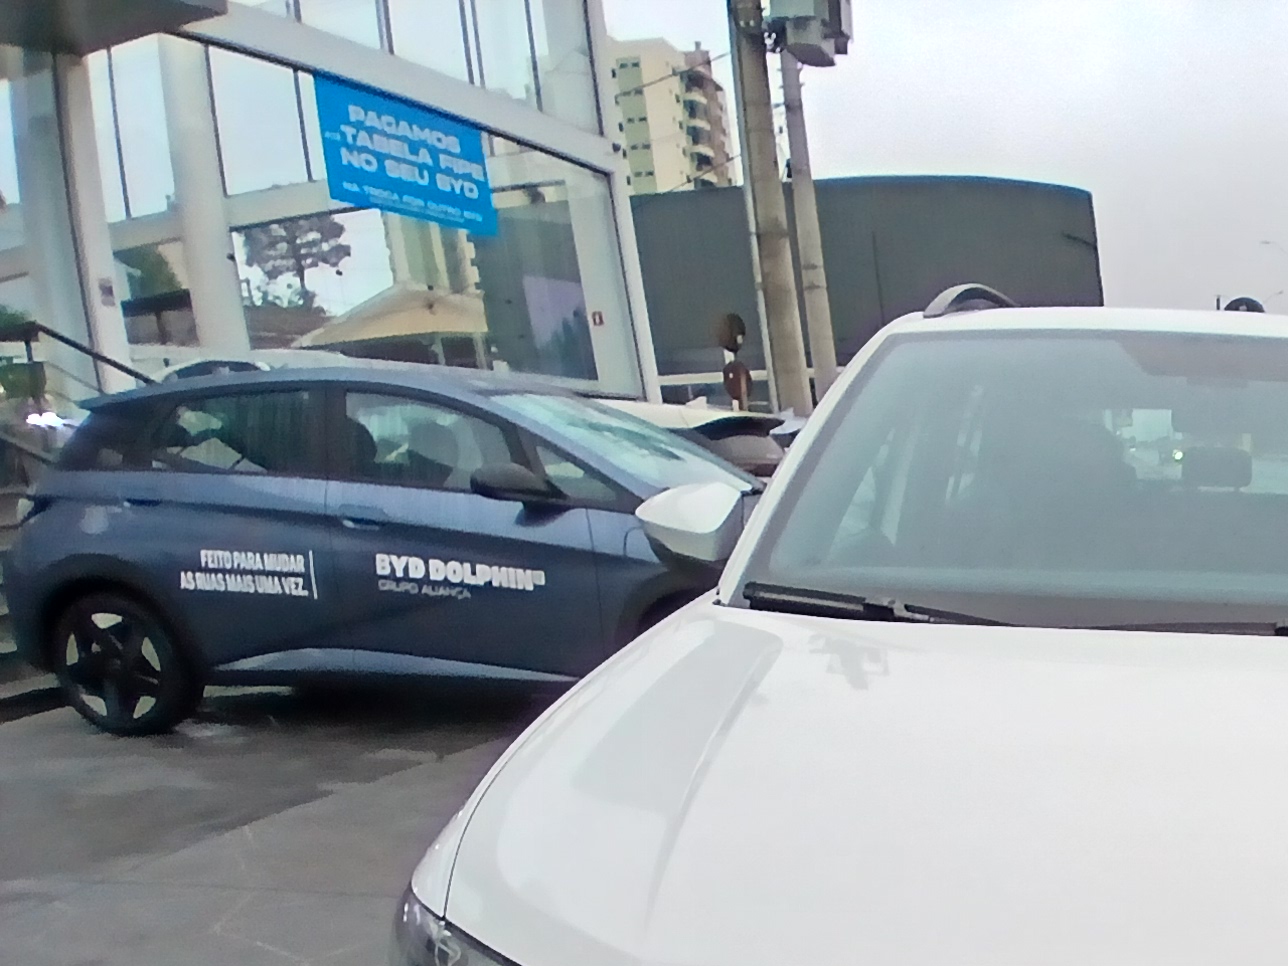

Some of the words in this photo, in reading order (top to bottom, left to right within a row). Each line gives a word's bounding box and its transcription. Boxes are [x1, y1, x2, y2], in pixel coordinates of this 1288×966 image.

[348, 105, 461, 153] PAGAMOS
[340, 124, 433, 166] TABELA
[439, 153, 485, 182] FIPE
[340, 147, 378, 172] NO
[384, 159, 429, 185] SEU
[436, 173, 479, 199] BYD
[200, 549, 232, 569] FEITO
[232, 551, 264, 570] PARA
[264, 552, 305, 573] MUDAR
[375, 553, 426, 578] BYD
[429, 558, 534, 591] DOLPHIN
[180, 571, 195, 590] AS
[195, 572, 225, 592] RUAS
[225, 573, 255, 593] MAIS
[255, 575, 282, 594] UMA
[282, 576, 309, 596] VEZ.
[378, 579, 419, 594] GRUPO
